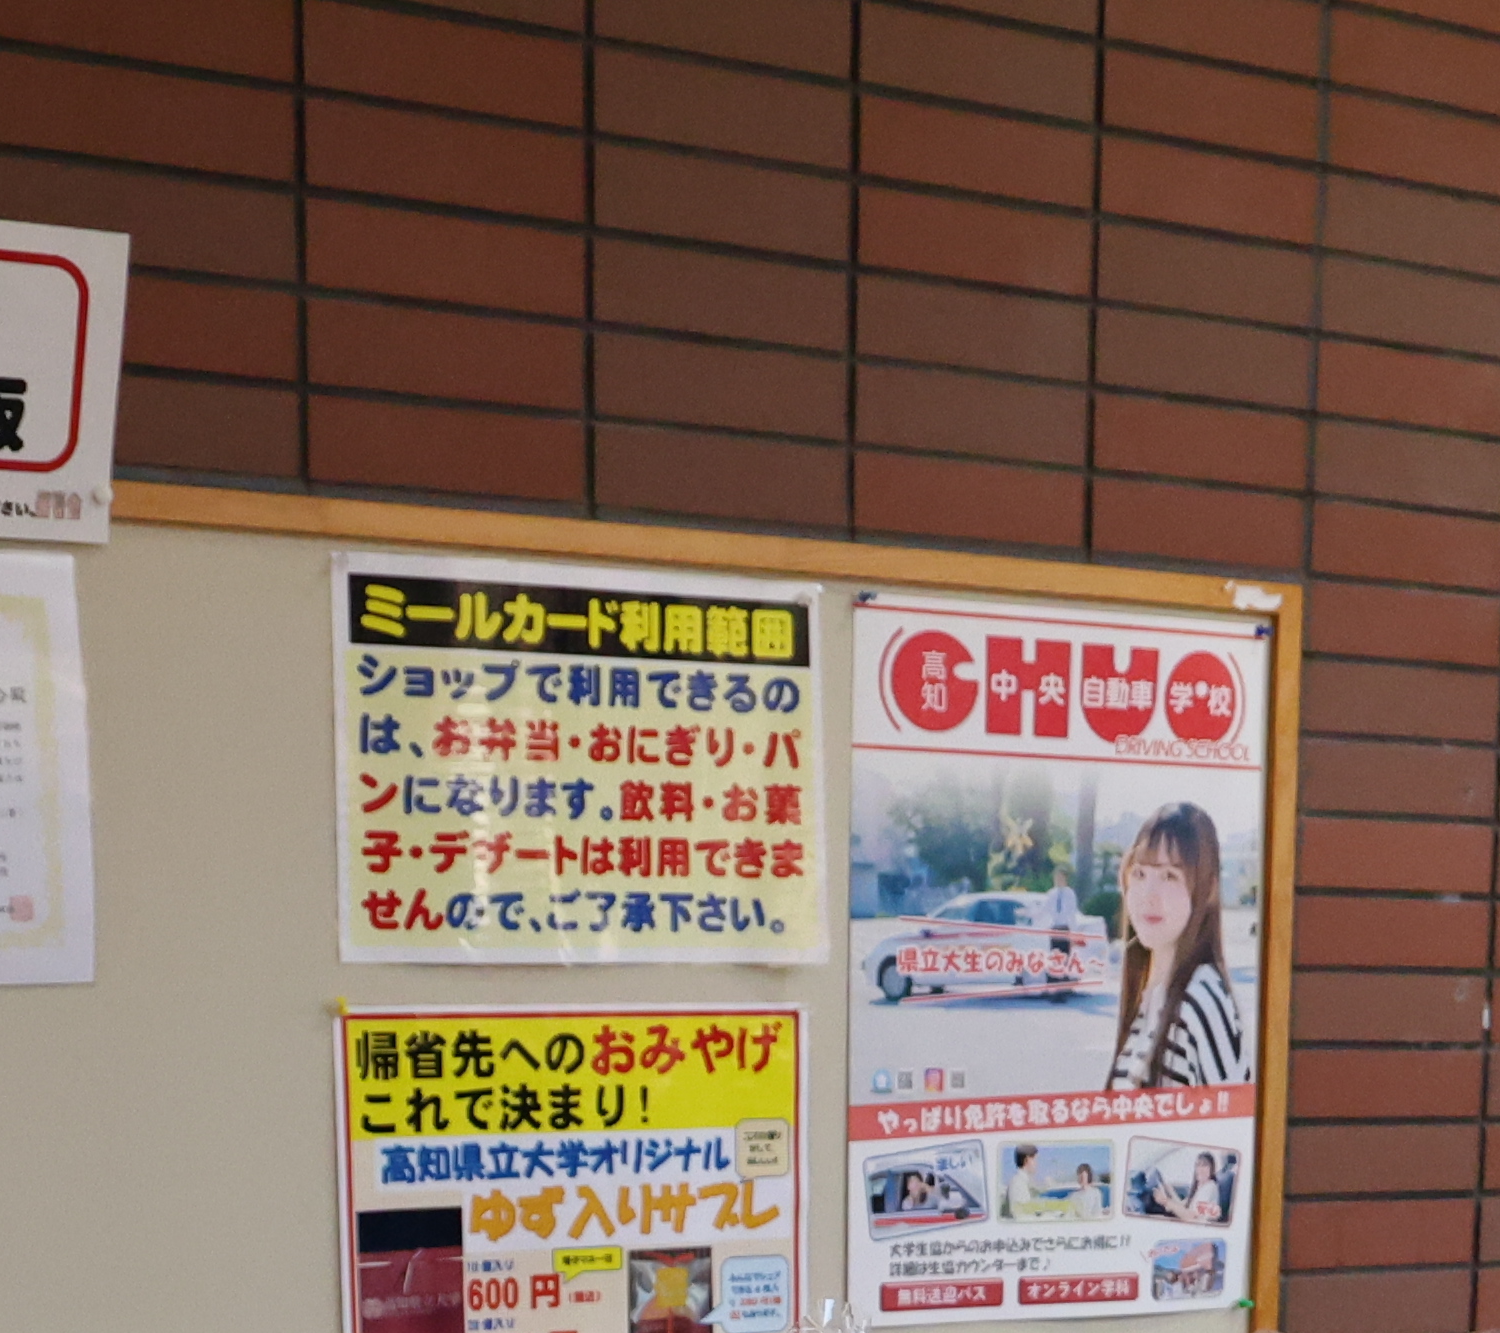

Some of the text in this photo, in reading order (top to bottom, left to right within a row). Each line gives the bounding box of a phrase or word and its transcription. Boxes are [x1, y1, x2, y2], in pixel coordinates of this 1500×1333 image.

[361, 583, 795, 659] ミールカード利用範囲
[357, 654, 801, 714] ショップで利用できるの
[920, 649, 949, 714] 高知
[359, 713, 801, 768] は、お弁当・おにぎり・パ
[1115, 734, 1250, 762] DRIVING SCHOOL
[359, 773, 802, 825] ンになります。飲料・お菓
[361, 831, 803, 878] 子・デザートは利用できま
[361, 889, 785, 934] せんので、ご了承下さい。
[356, 1021, 783, 1081] 帰省先へのおみやげ
[381, 1137, 730, 1184] 高知県立大学オリジナル
[470, 1180, 779, 1241] ゆず入りサブレ
[468, 1277, 518, 1311] 600
